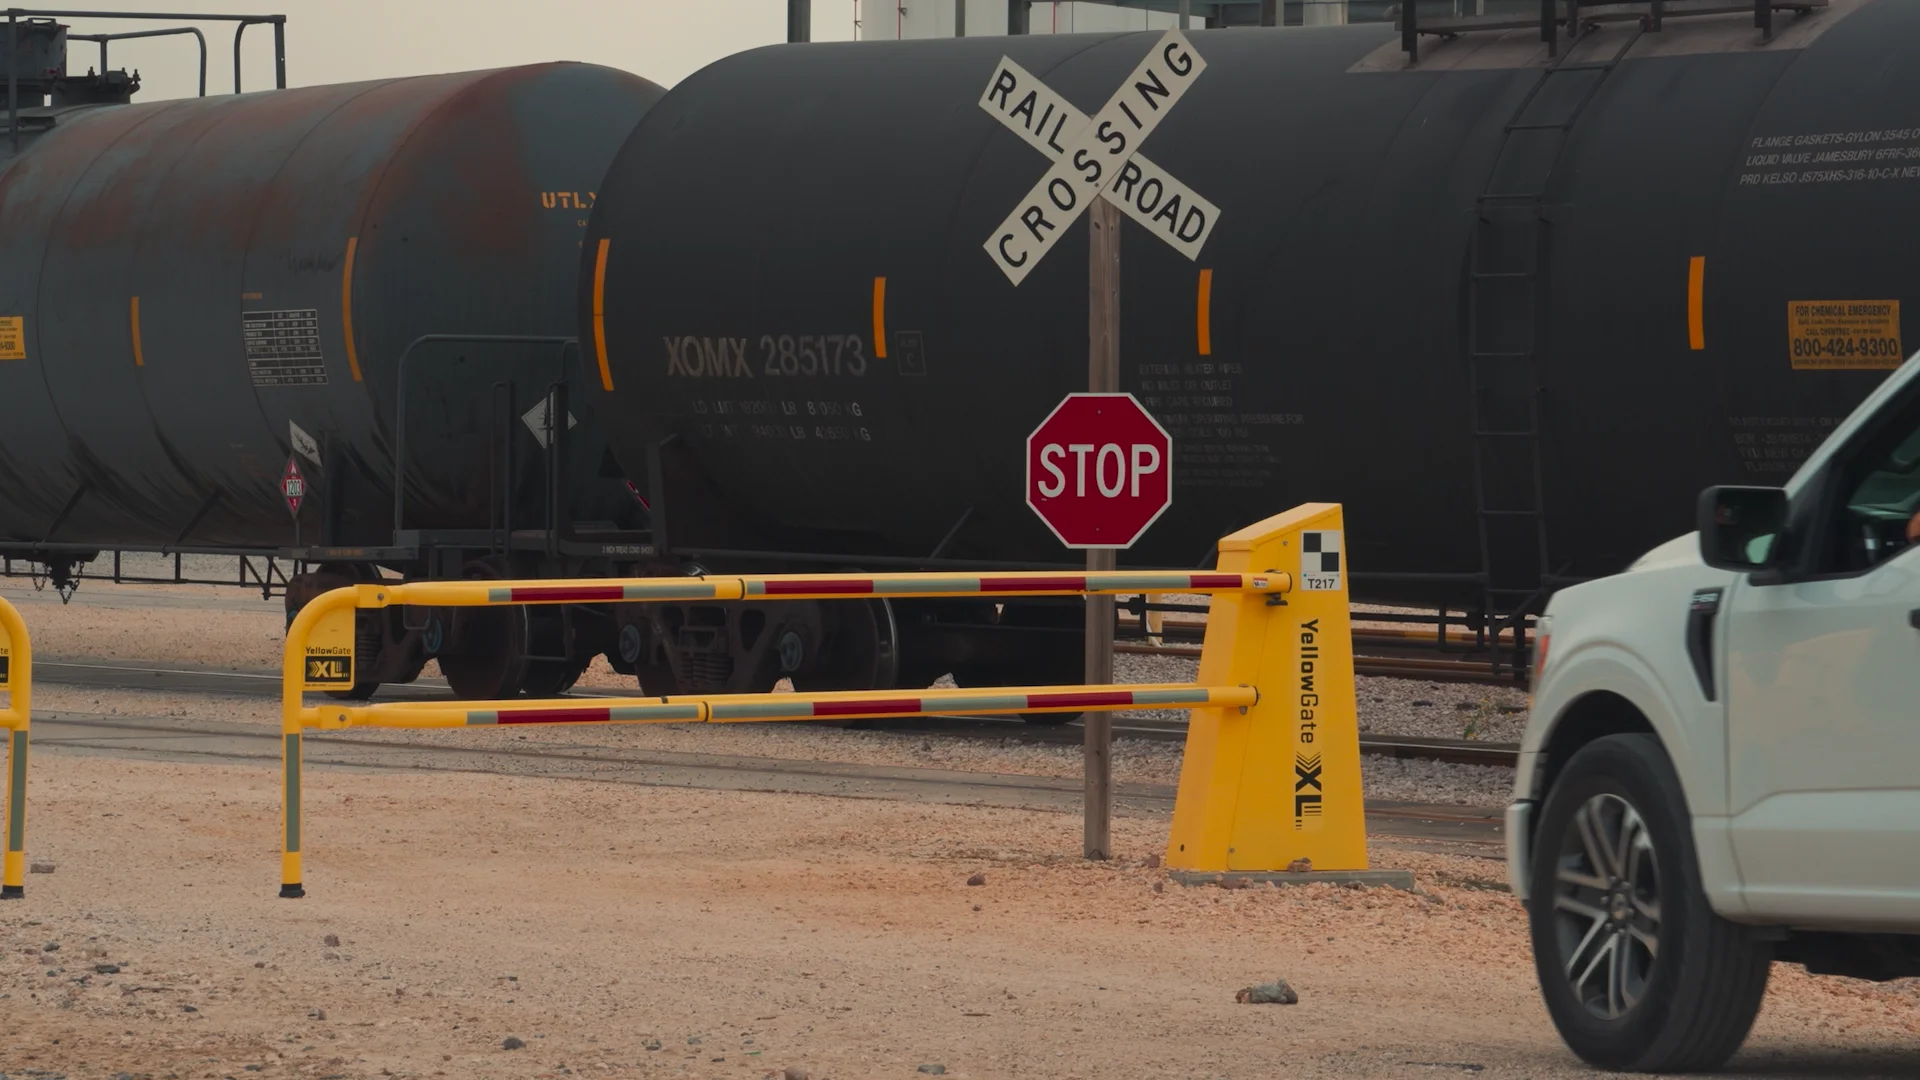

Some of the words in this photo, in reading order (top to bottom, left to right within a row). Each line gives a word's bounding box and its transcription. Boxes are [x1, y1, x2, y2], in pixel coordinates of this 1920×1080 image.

[1752, 136, 1794, 148] FLANGE
[1795, 131, 1882, 146] GASKETS-GYLON
[1882, 128, 1911, 140] 3545
[988, 69, 1068, 154] RAIL
[1112, 160, 1206, 243] ROAD
[999, 43, 1192, 267] CROSSING
[1746, 154, 1780, 166] LIQUID
[1782, 152, 1812, 164] VALVE
[1812, 149, 1875, 163] JAMESBURY
[1876, 147, 1920, 160] 6FRF-36
[1739, 173, 1761, 185] PRD
[1762, 172, 1797, 184] KELSO
[1795, 305, 1810, 317] FOR
[1811, 304, 1847, 317] CHEMICAL
[1848, 304, 1892, 317] EMERGENCY
[662, 335, 754, 378] XOMX
[759, 333, 868, 378] 285173
[1793, 337, 1898, 357] 800-424-9300
[781, 400, 798, 415] LB
[807, 401, 842, 416] 8050
[1286, 414, 1304, 424] FOR
[789, 424, 807, 439] LB
[1037, 442, 1160, 498] STOP
[287, 479, 302, 496] 1203
[1308, 578, 1336, 590] T217
[305, 646, 351, 656] YellowGate
[314, 660, 345, 678] XL
[1300, 618, 1319, 744] YellowGate
[1295, 760, 1322, 819] XL
